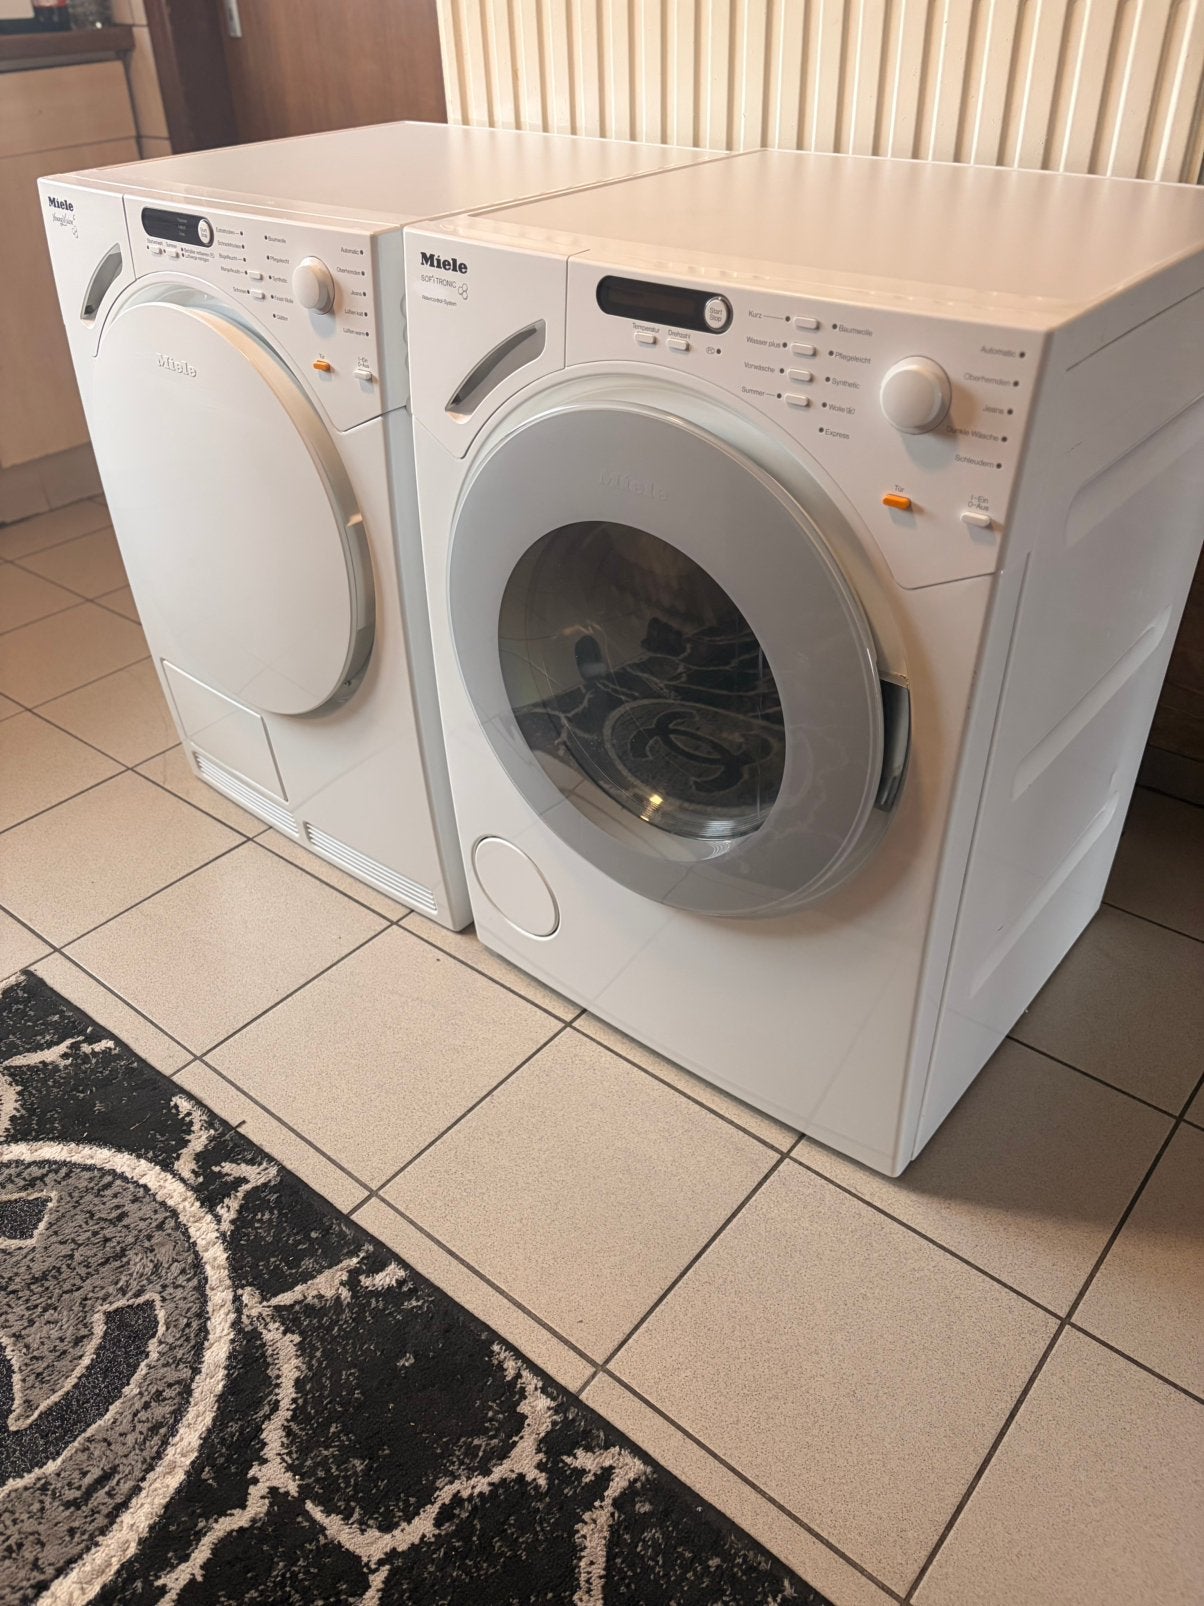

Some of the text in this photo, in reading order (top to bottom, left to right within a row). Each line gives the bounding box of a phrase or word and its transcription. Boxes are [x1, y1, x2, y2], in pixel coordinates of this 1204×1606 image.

[48, 196, 74, 212] Miele
[420, 251, 468, 274] Miele
[710, 314, 722, 322] Stop
[748, 310, 762, 318] Kurz
[632, 322, 660, 333] Temperatur
[838, 324, 872, 336] Baumwolle
[746, 336, 780, 348] Wasser plus
[835, 352, 872, 364] Pflegeleicht
[980, 346, 1016, 358] Automatic
[156, 352, 197, 378] Miele
[744, 362, 776, 373] Vorwäsche
[832, 378, 860, 390] Synthetic
[964, 372, 1011, 386] Oberhemden
[742, 386, 766, 396] Summer
[982, 404, 1004, 414] Jeans
[825, 428, 850, 440] Express
[971, 430, 999, 442] Wäsche
[954, 454, 994, 468] Schleudern
[894, 484, 904, 492] Tür
